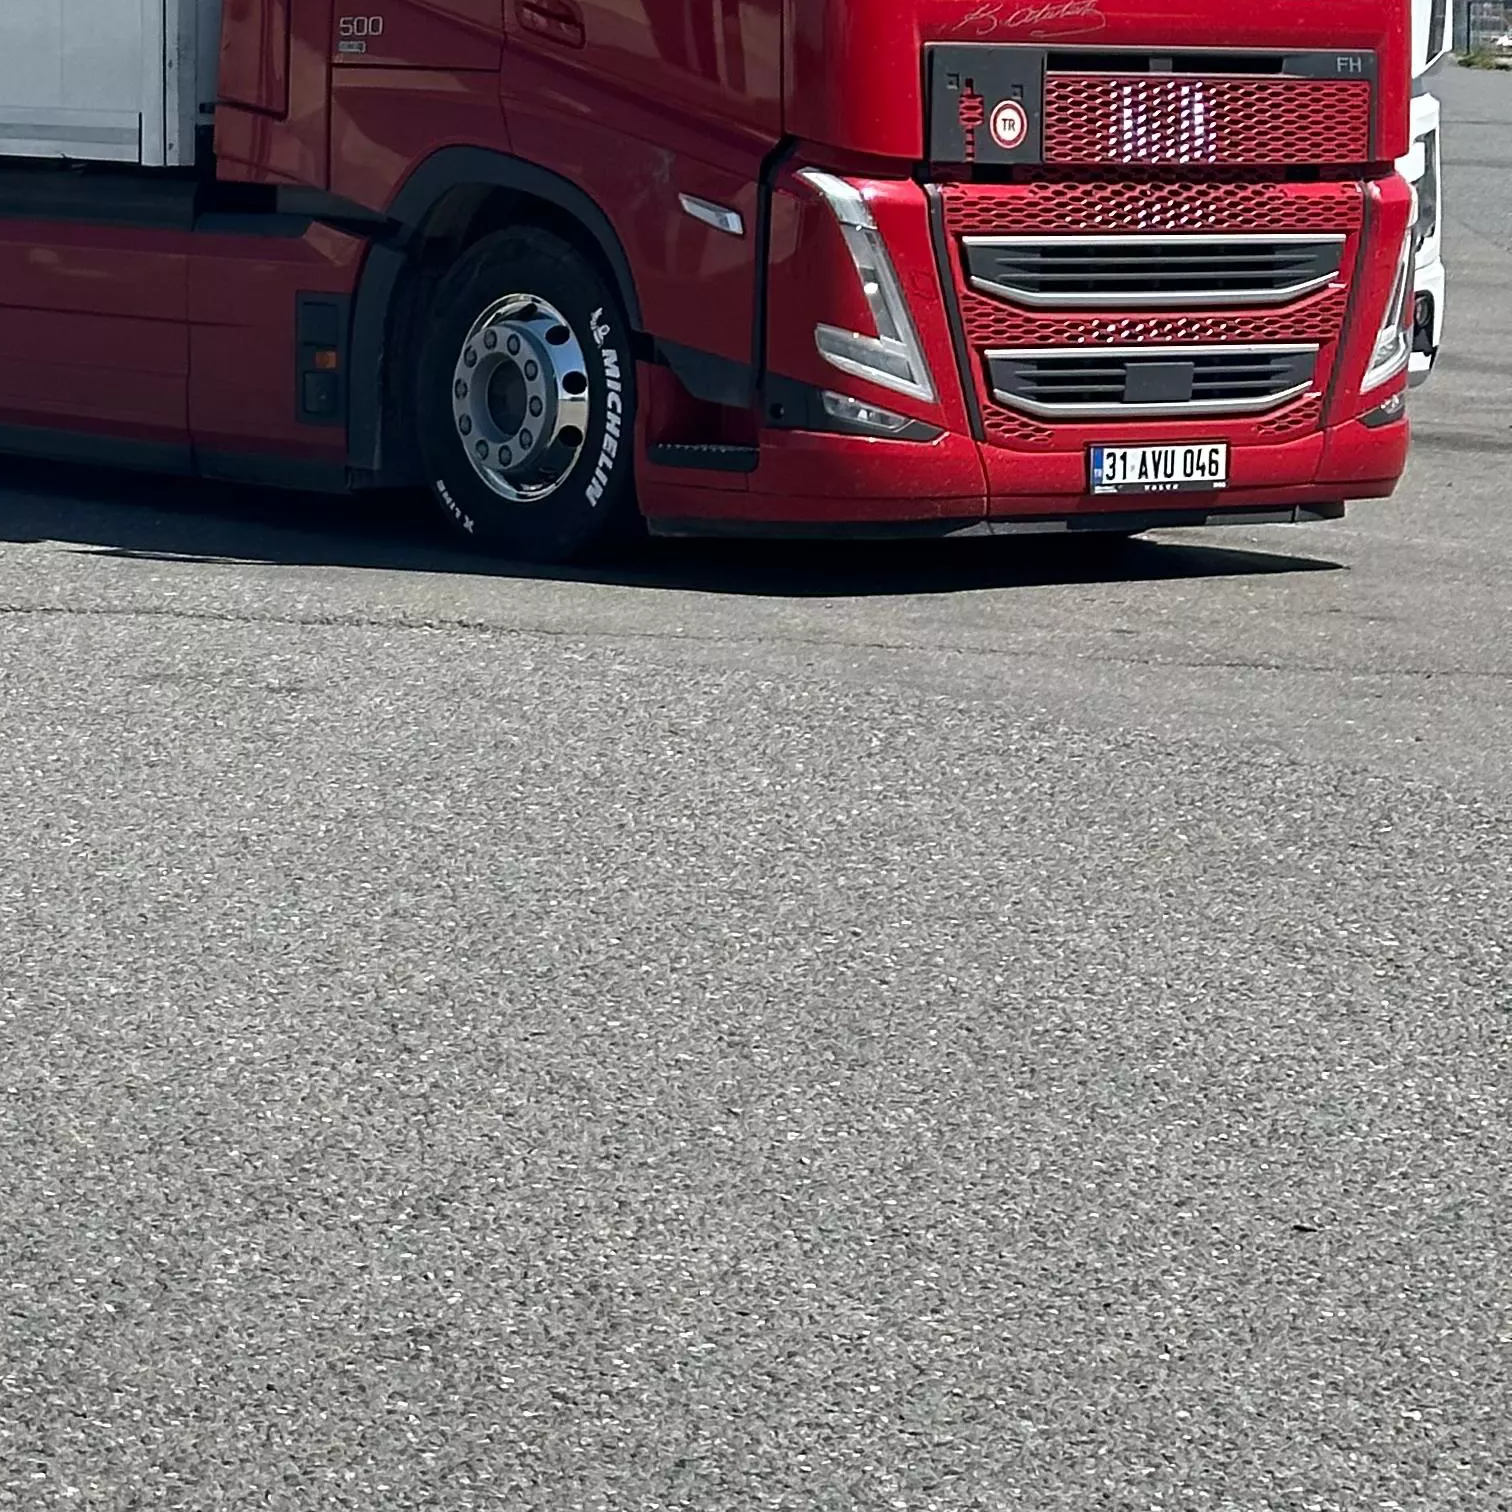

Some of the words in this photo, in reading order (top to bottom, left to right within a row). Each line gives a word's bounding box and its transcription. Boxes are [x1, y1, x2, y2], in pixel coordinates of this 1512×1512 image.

[339, 16, 383, 36] 500
[1337, 56, 1362, 73] FH
[1001, 118, 1016, 132] TR
[585, 348, 623, 508] MICHELIN
[1105, 450, 1128, 481] 31
[1138, 449, 1176, 480] AVU
[1183, 447, 1220, 478] 046
